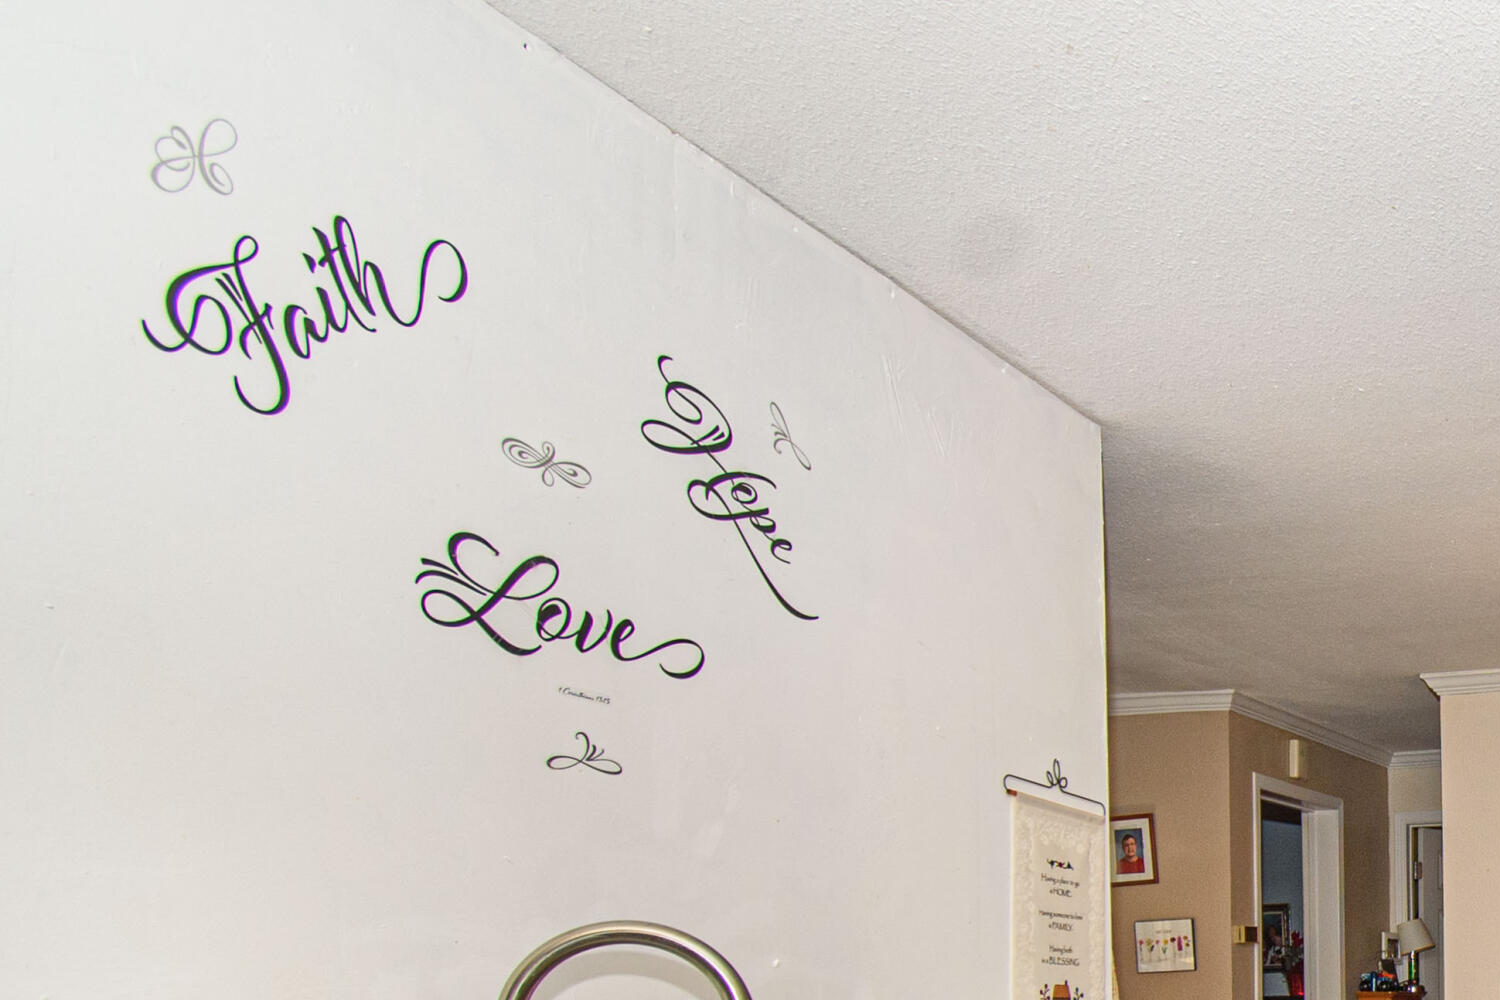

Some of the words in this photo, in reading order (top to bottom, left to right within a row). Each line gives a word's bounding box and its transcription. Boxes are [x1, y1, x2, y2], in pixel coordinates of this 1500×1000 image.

[141, 214, 469, 416] Faith
[640, 355, 819, 620] Hope
[415, 531, 705, 680] Love
